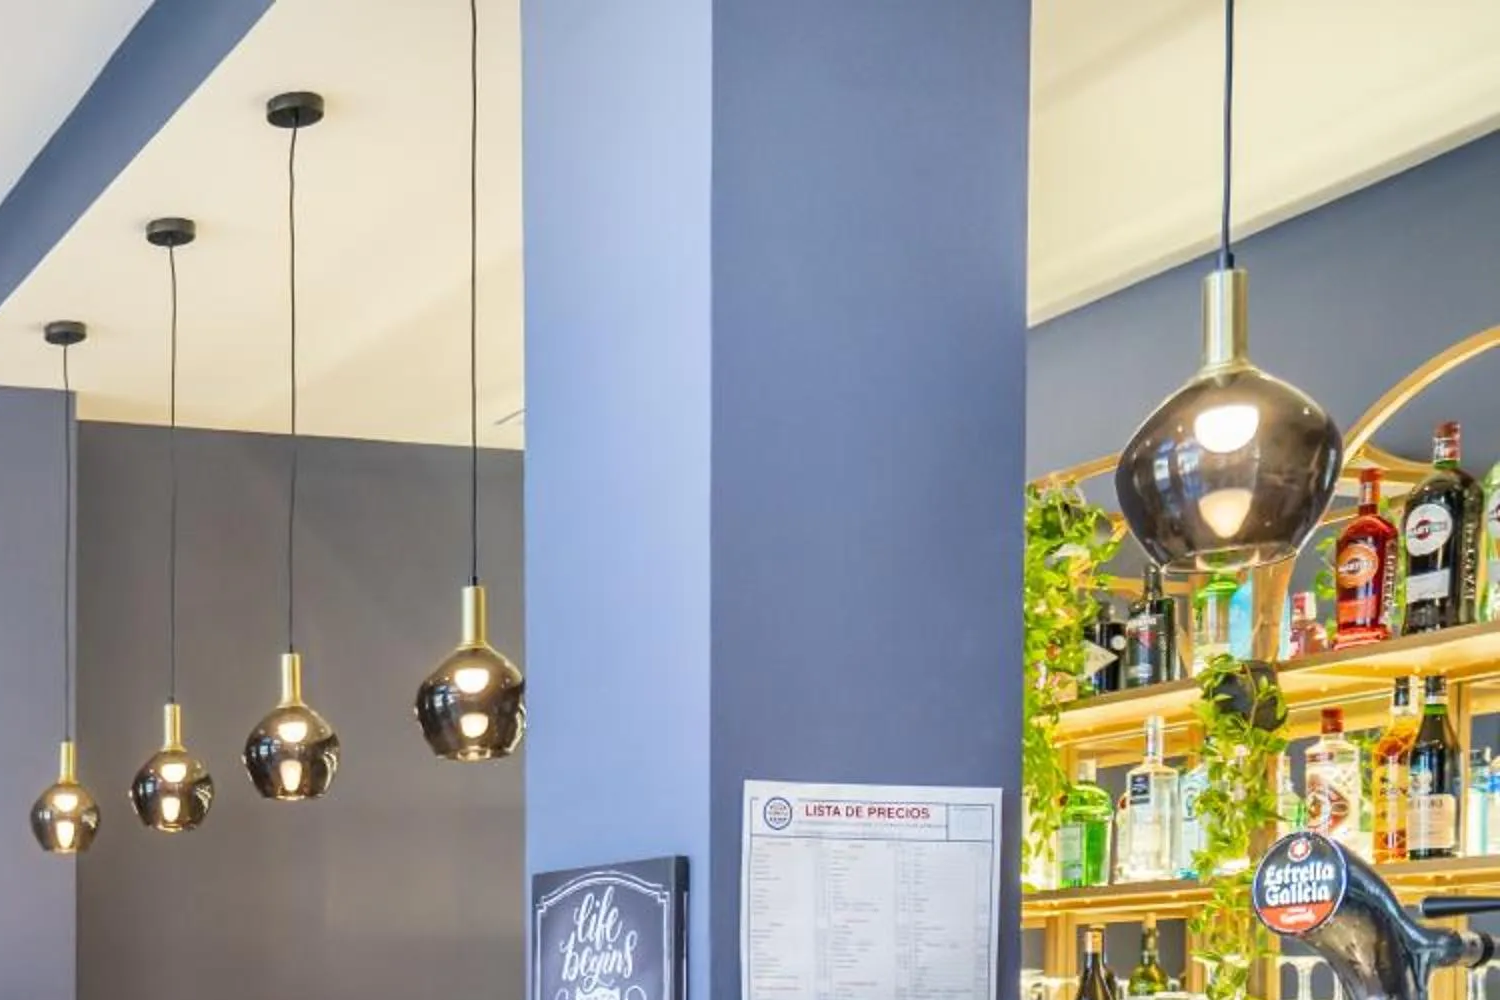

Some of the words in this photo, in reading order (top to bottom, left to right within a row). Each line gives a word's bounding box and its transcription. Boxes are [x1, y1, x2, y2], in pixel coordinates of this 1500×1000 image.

[804, 803, 841, 817] LISTA
[845, 805, 865, 818] DE
[867, 806, 931, 820] PRECIOS
[1264, 861, 1335, 886] Estrella
[1265, 881, 1331, 906] Galicia
[573, 886, 623, 950] life
[560, 930, 638, 992] begins
